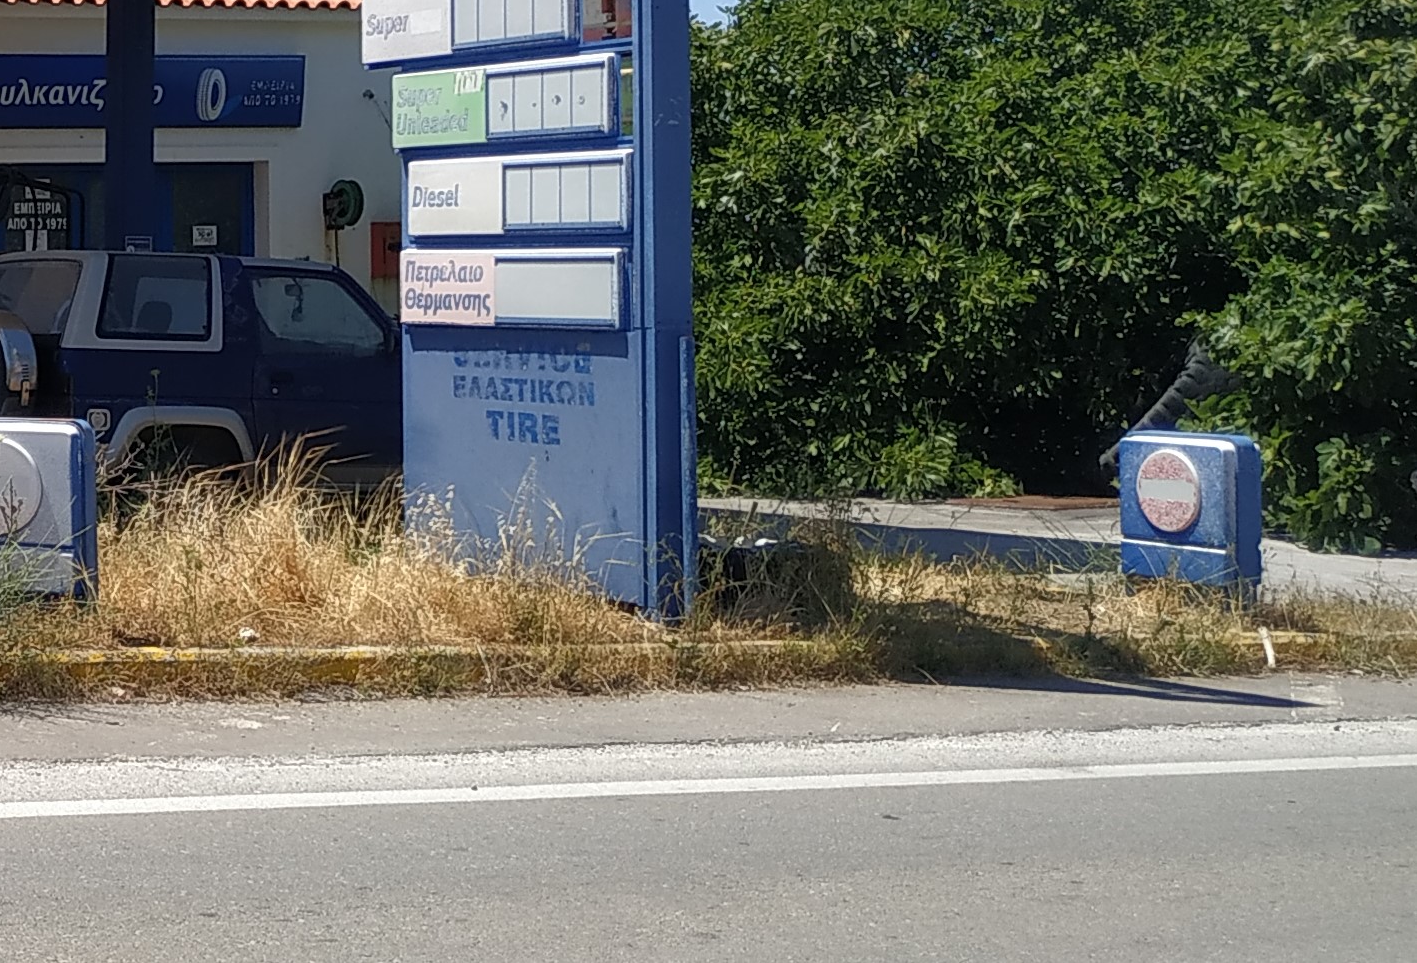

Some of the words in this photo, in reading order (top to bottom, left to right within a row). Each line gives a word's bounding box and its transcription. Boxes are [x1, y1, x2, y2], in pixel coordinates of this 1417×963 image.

[365, 14, 410, 41] Super
[396, 86, 443, 113] Super
[396, 108, 469, 136] Unleaded
[13, 201, 62, 215] ΕΜΠΕΙΡΙΑ
[412, 183, 460, 208] Diesel
[7, 217, 28, 230] ΑΠΟ
[452, 375, 595, 406] ΕΛΑΣΤΙΚΩΝ
[486, 410, 560, 445] TIRE
